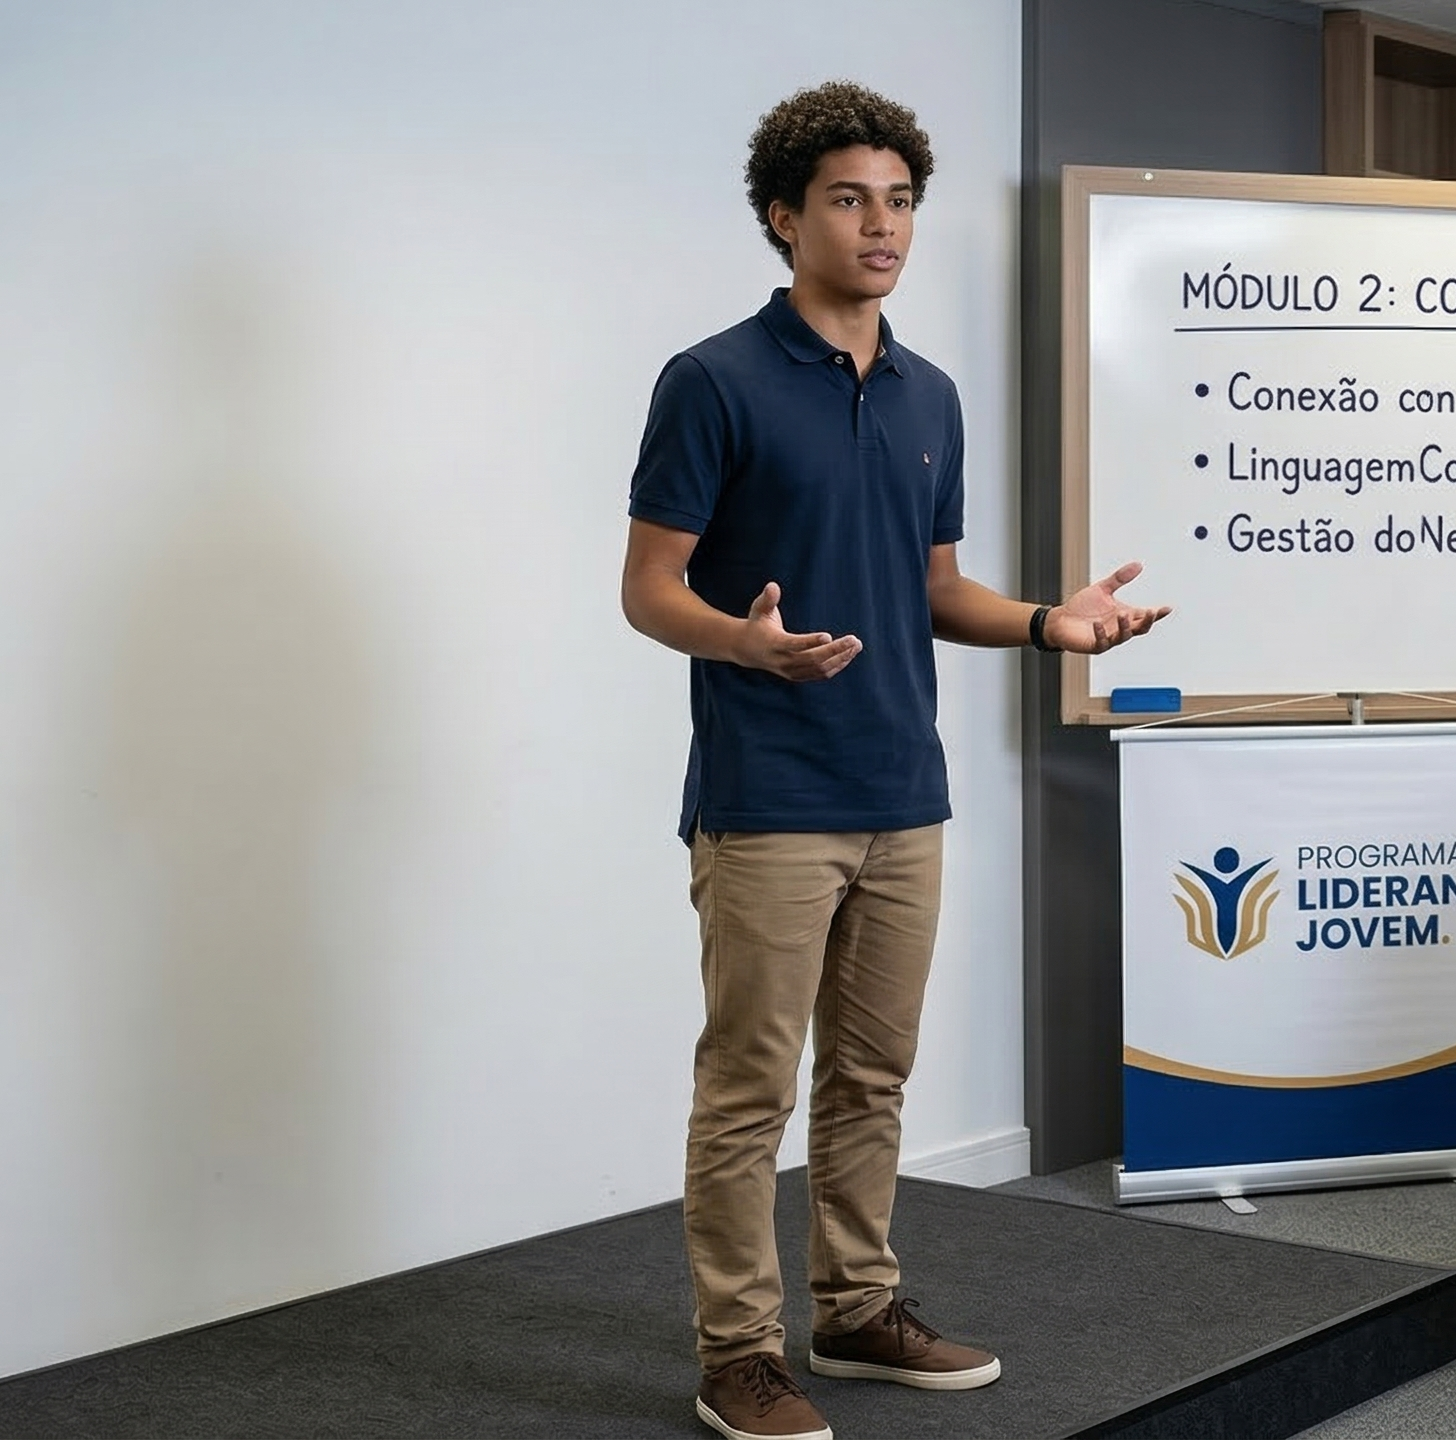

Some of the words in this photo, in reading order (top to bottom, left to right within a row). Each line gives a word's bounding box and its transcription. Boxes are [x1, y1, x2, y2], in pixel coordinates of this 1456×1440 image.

[1184, 263, 1338, 312] MÓDULO
[1360, 274, 1395, 312] 2:
[1228, 372, 1379, 412] Conexão
[1227, 513, 1355, 553] Gestão
[1296, 914, 1450, 952] JOVEM.
